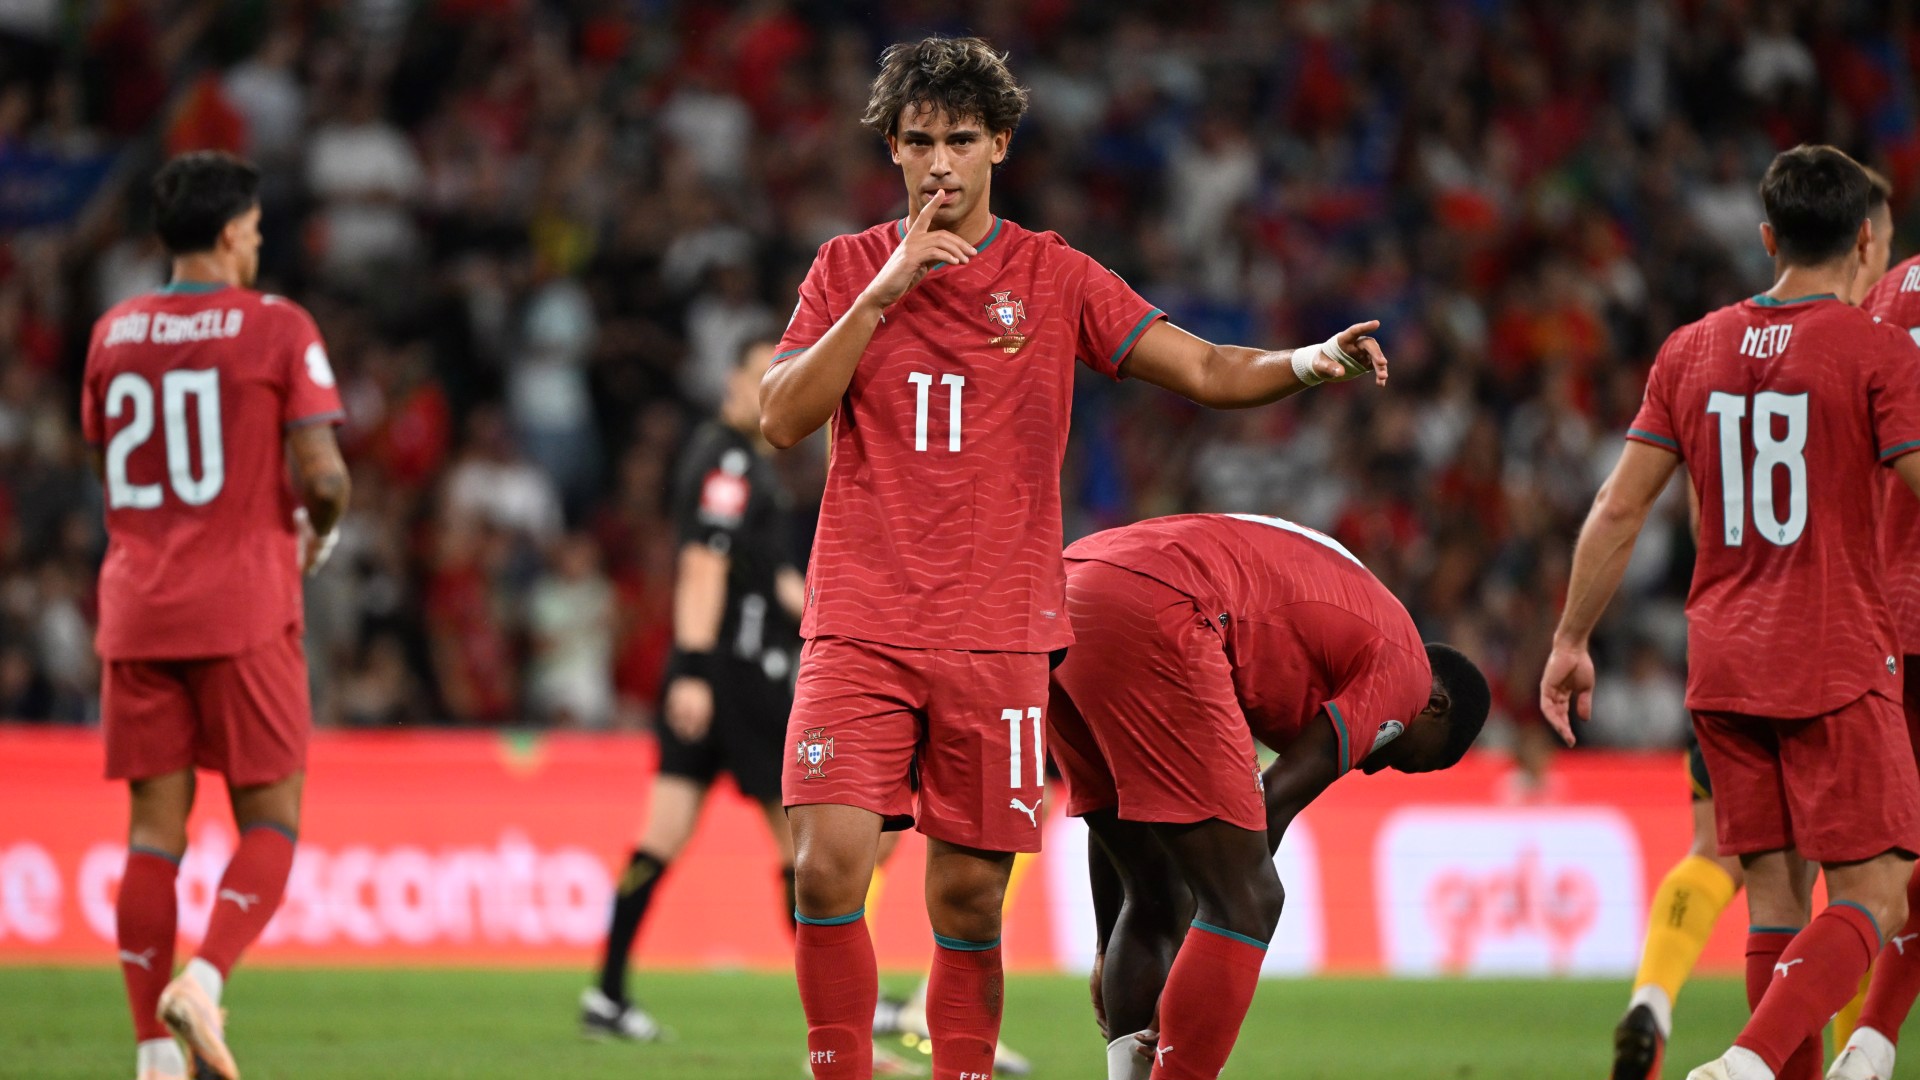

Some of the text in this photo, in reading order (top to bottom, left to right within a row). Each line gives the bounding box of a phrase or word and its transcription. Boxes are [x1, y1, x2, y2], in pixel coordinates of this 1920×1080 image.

[1739, 323, 1793, 359] NETO
[105, 367, 225, 509] 20
[907, 371, 966, 453] 11
[1706, 391, 1808, 547] 18
[1000, 706, 1045, 789] 11
[174, 822, 611, 945] dsconto
